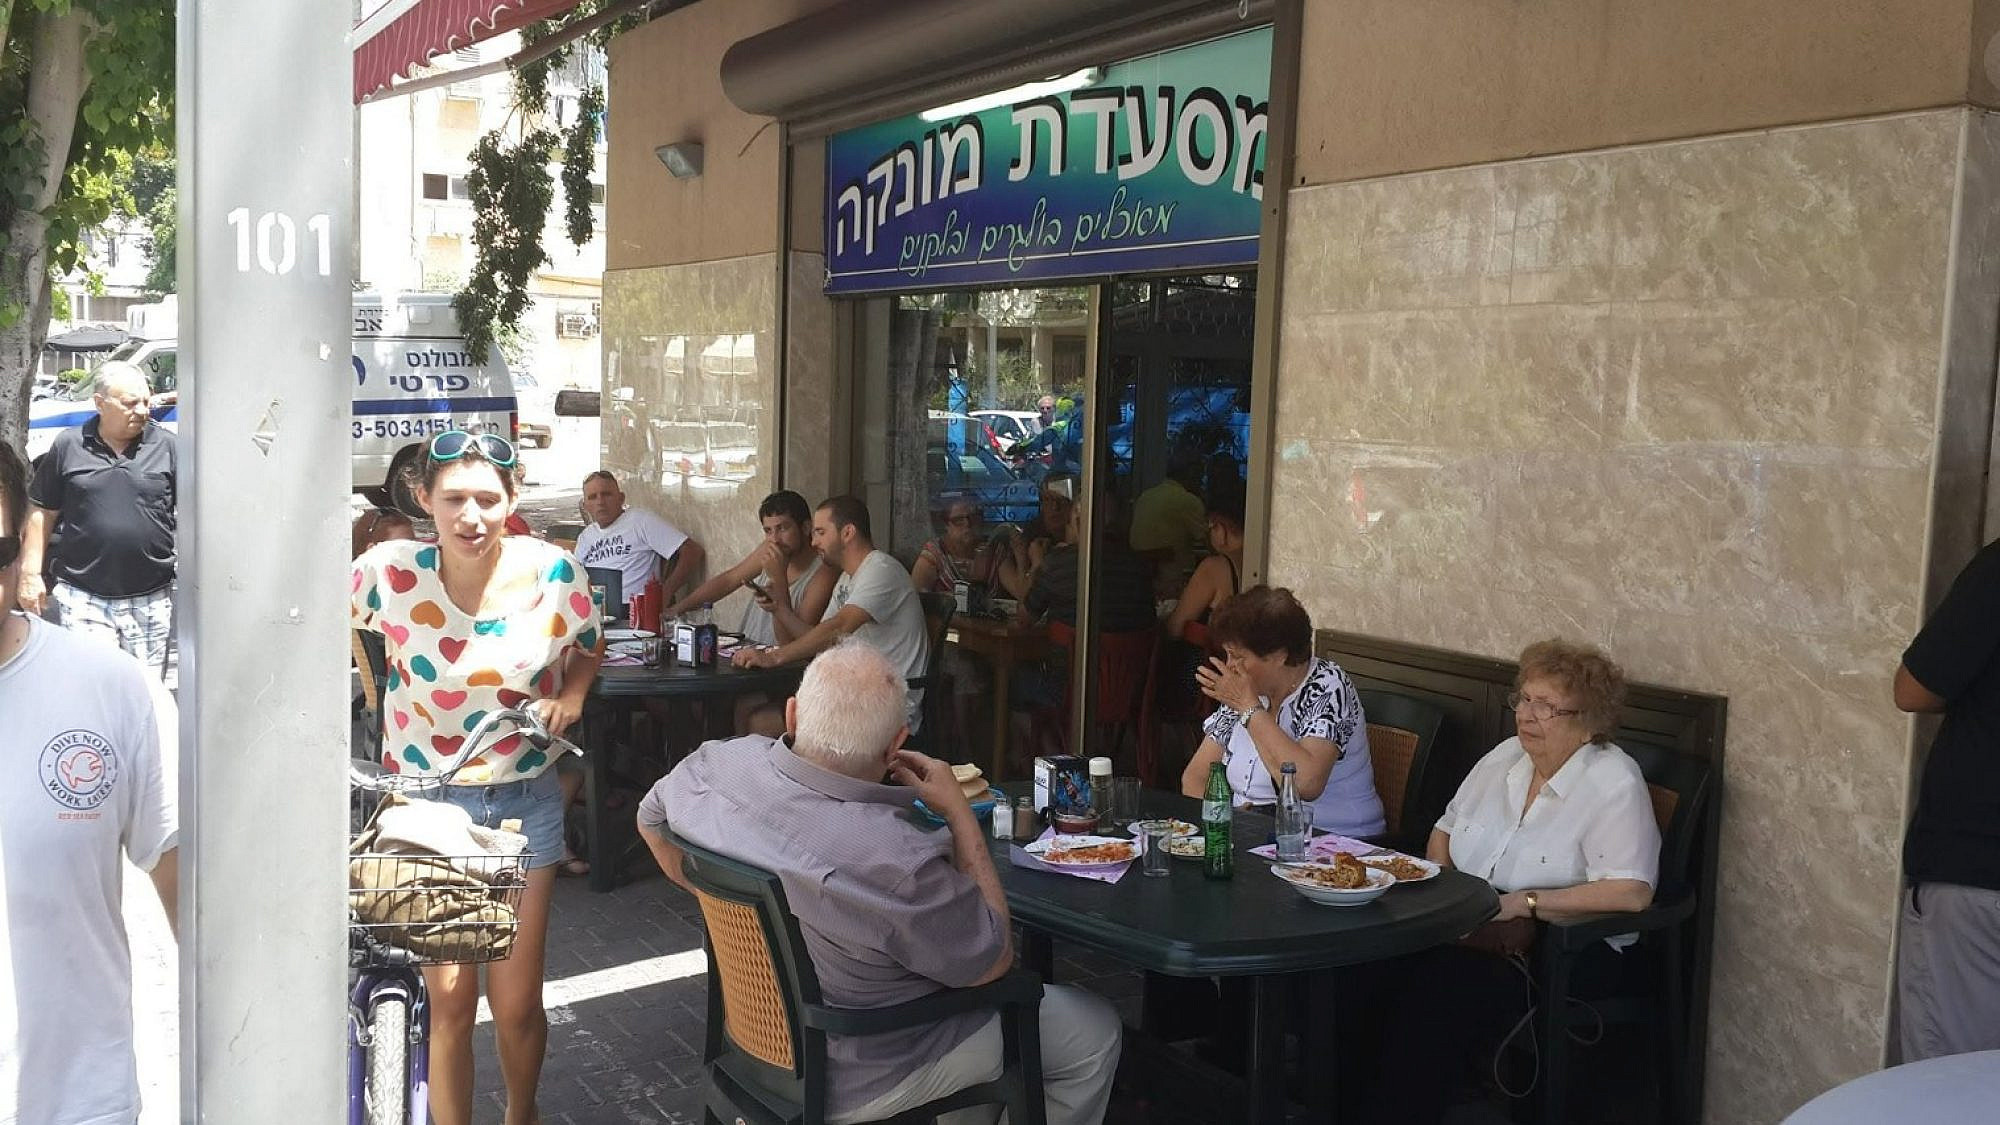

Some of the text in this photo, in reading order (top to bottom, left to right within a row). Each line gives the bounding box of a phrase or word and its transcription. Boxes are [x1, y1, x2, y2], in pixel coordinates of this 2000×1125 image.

[836, 86, 1268, 257] מסעדת מונקה
[227, 207, 331, 276] 101
[976, 196, 1061, 273] בולגרים
[1070, 185, 1178, 256] מאכלים
[406, 349, 487, 367] מבולנס
[390, 375, 470, 393] פרטי
[50, 734, 112, 758] DIVE NOW
[48, 778, 81, 807] WORK
